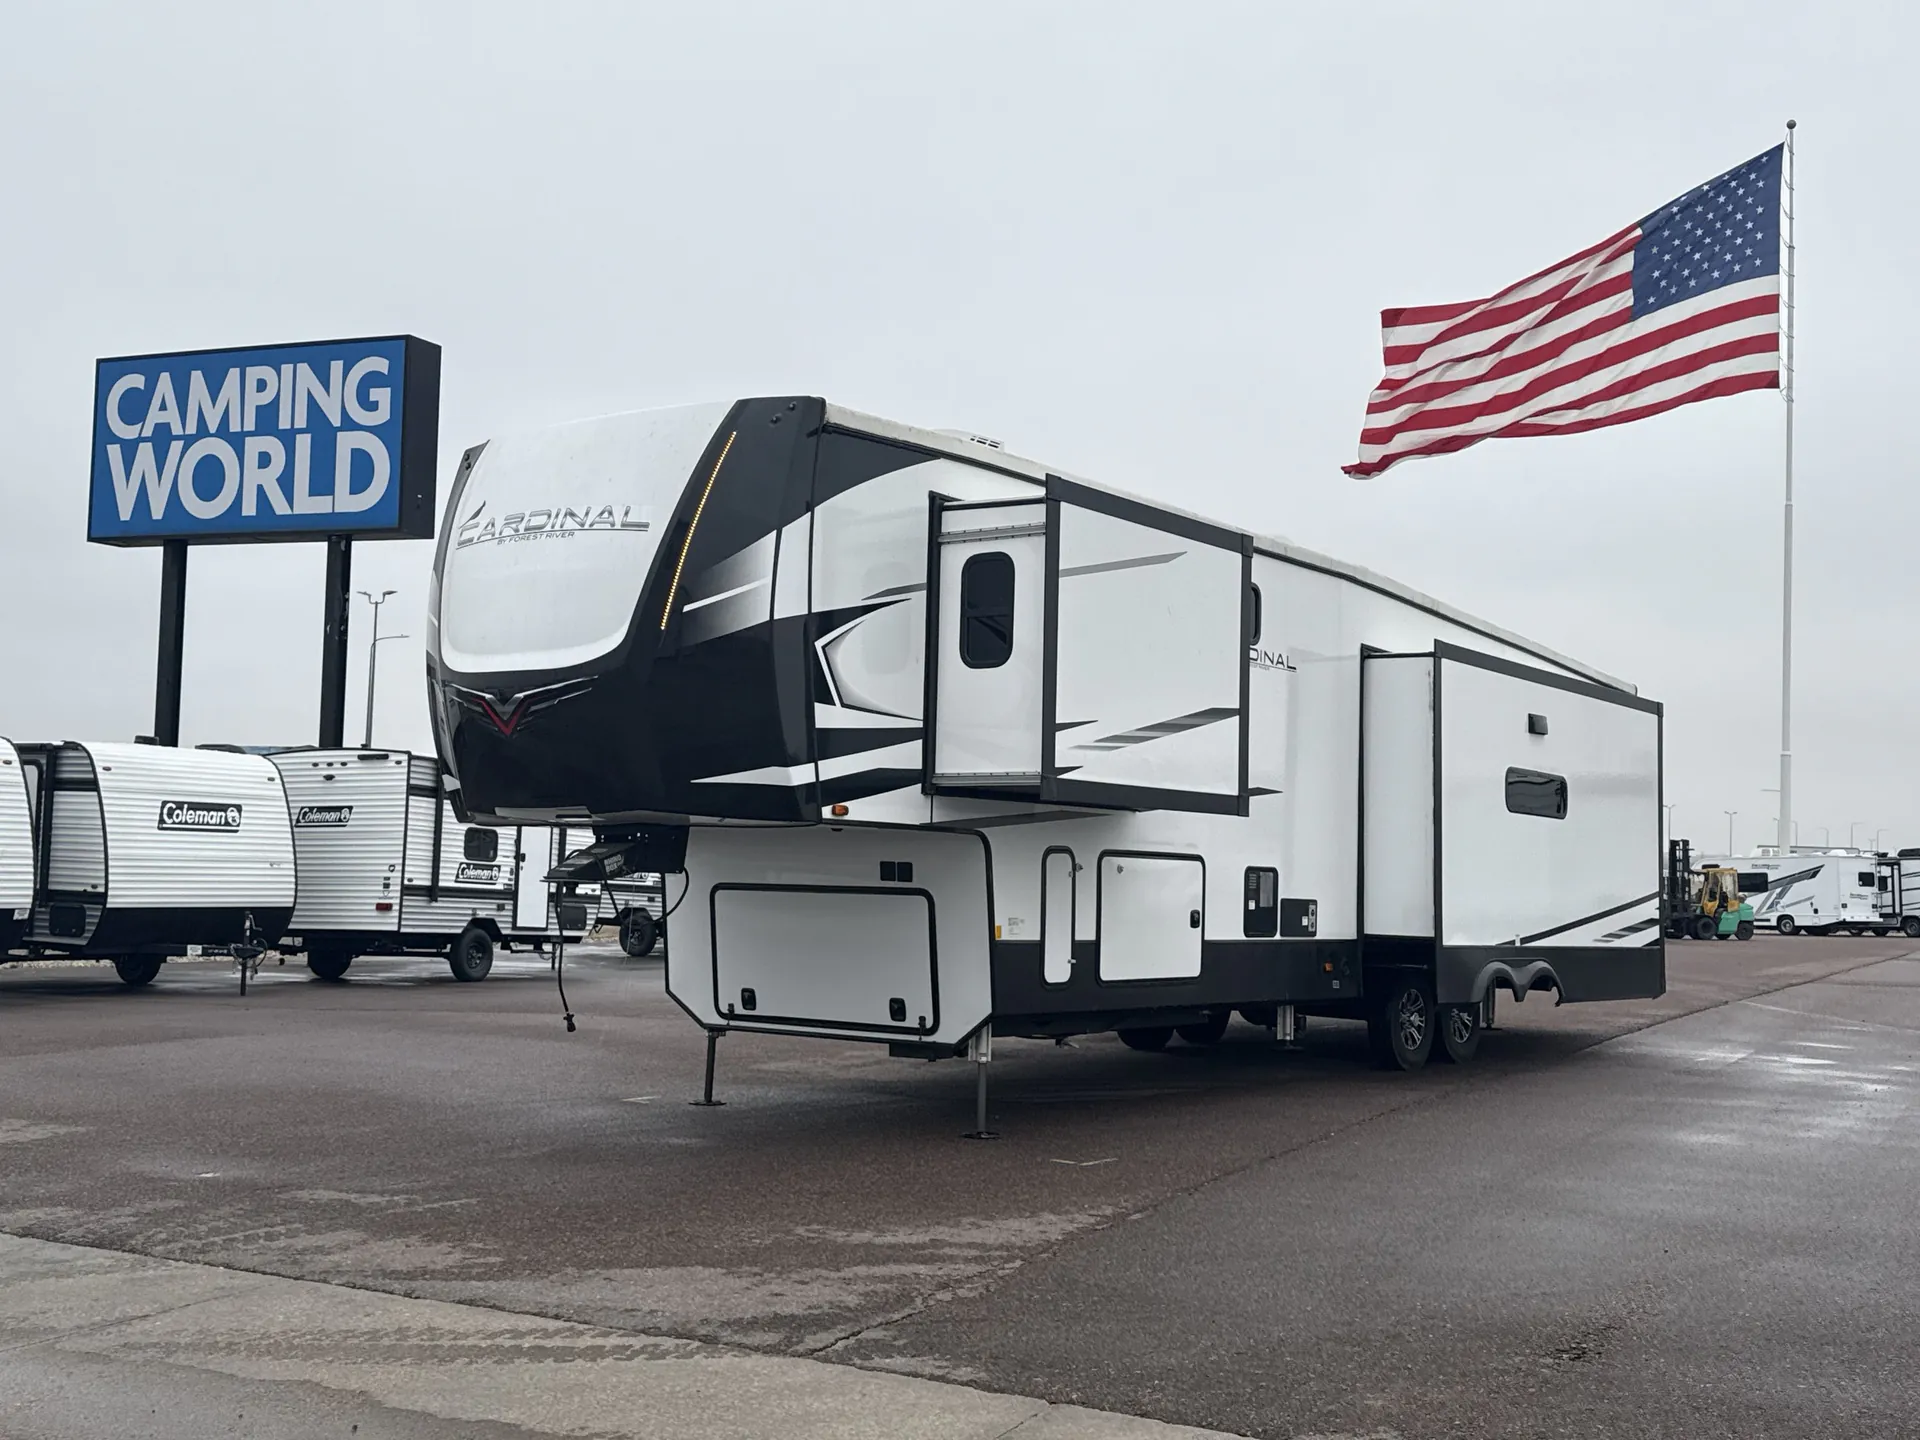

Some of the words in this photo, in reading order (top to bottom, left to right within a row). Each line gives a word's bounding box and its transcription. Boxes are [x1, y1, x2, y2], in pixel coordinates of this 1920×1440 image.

[106, 356, 391, 440] CAMPING
[106, 431, 391, 521] WORLD
[457, 501, 650, 546] CARDINAL
[508, 534, 544, 543] FOREST
[545, 531, 575, 540] RIVER
[1249, 647, 1297, 670] DINAL
[163, 802, 226, 825] Coleman
[300, 807, 340, 823] Coleman
[458, 863, 492, 880] Coleman
